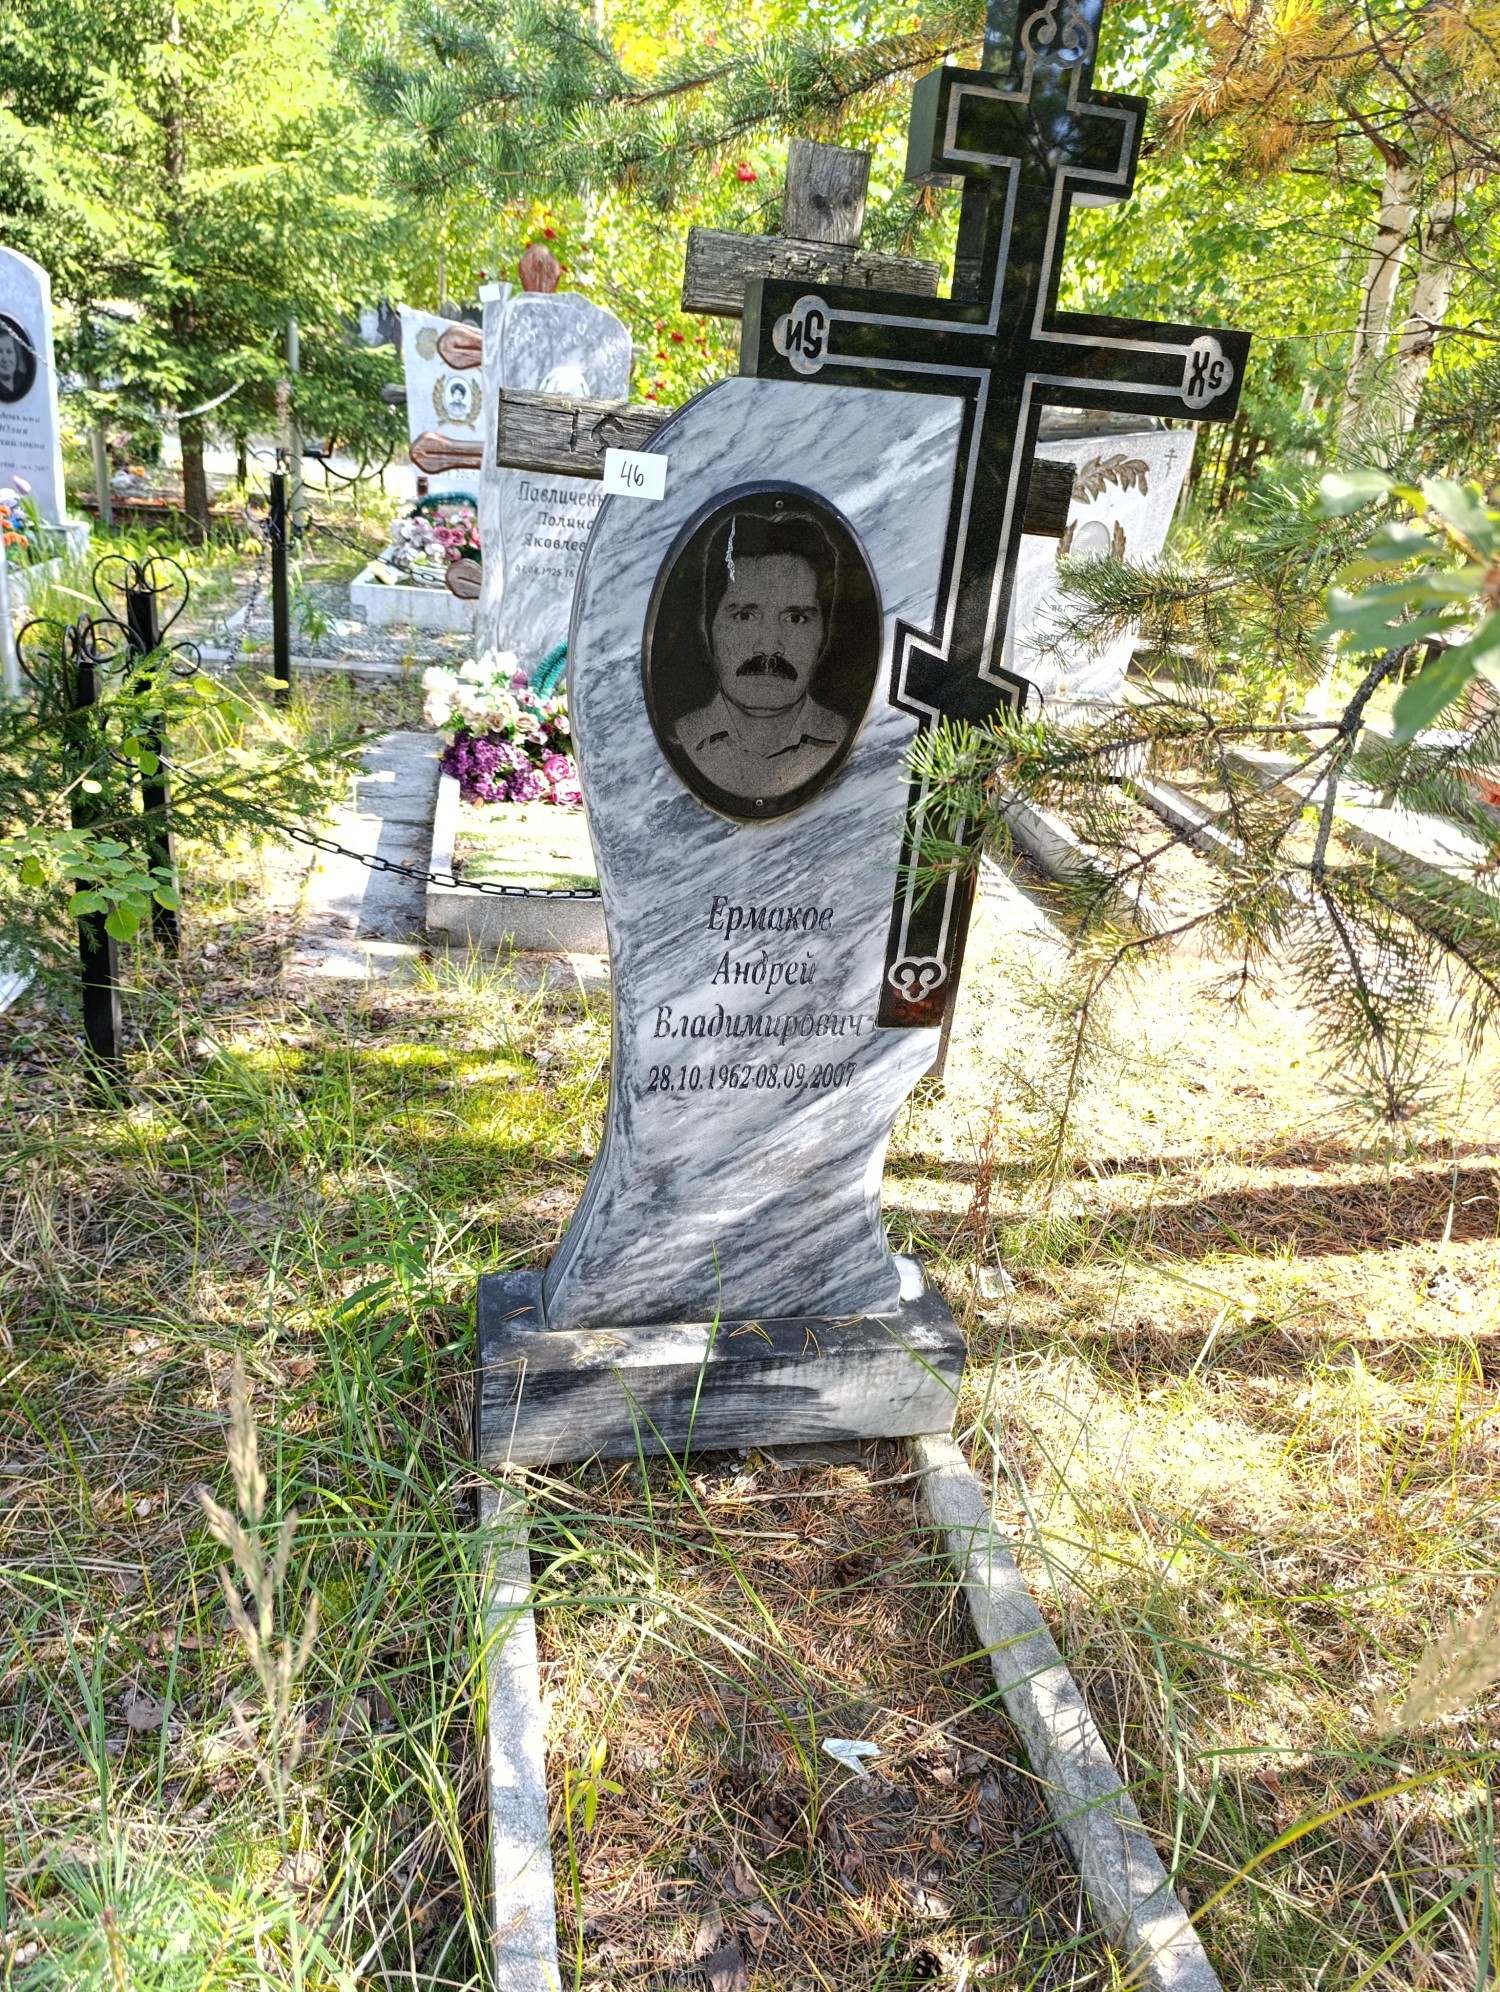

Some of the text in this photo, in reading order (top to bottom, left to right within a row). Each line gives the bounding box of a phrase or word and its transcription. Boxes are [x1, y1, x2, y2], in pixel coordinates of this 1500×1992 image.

[620, 460, 645, 488] 46
[708, 896, 833, 940] Ермаков
[711, 950, 817, 994] Андрей
[653, 1003, 863, 1046] Владимирович
